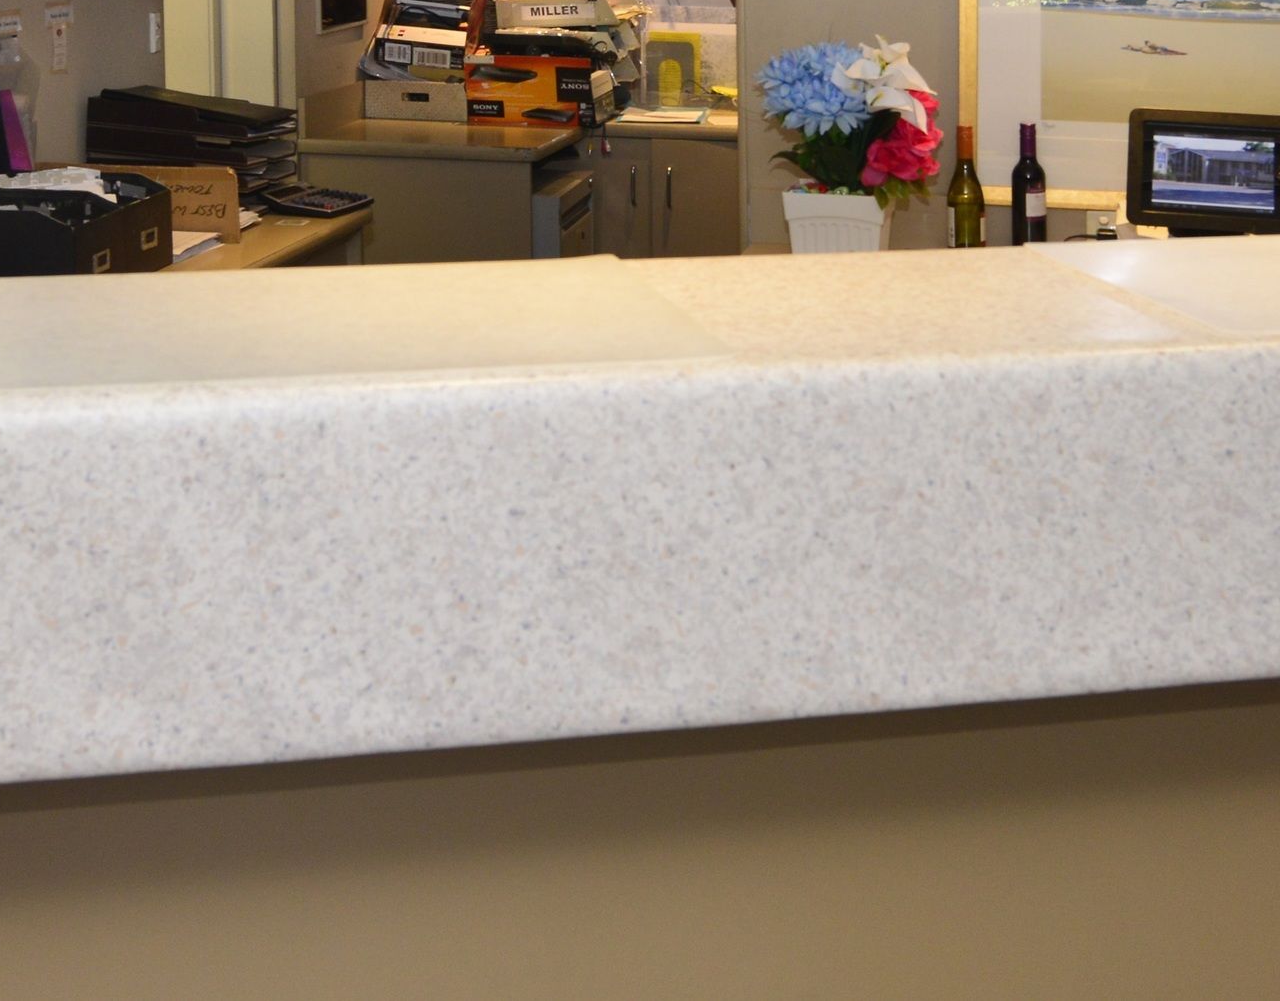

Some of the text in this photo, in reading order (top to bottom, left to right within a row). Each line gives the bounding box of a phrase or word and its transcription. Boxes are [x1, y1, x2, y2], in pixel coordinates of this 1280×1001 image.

[530, 5, 579, 16] MILLER
[560, 82, 590, 90] SONY
[472, 103, 498, 111] SONY
[170, 184, 213, 195] TOWE
